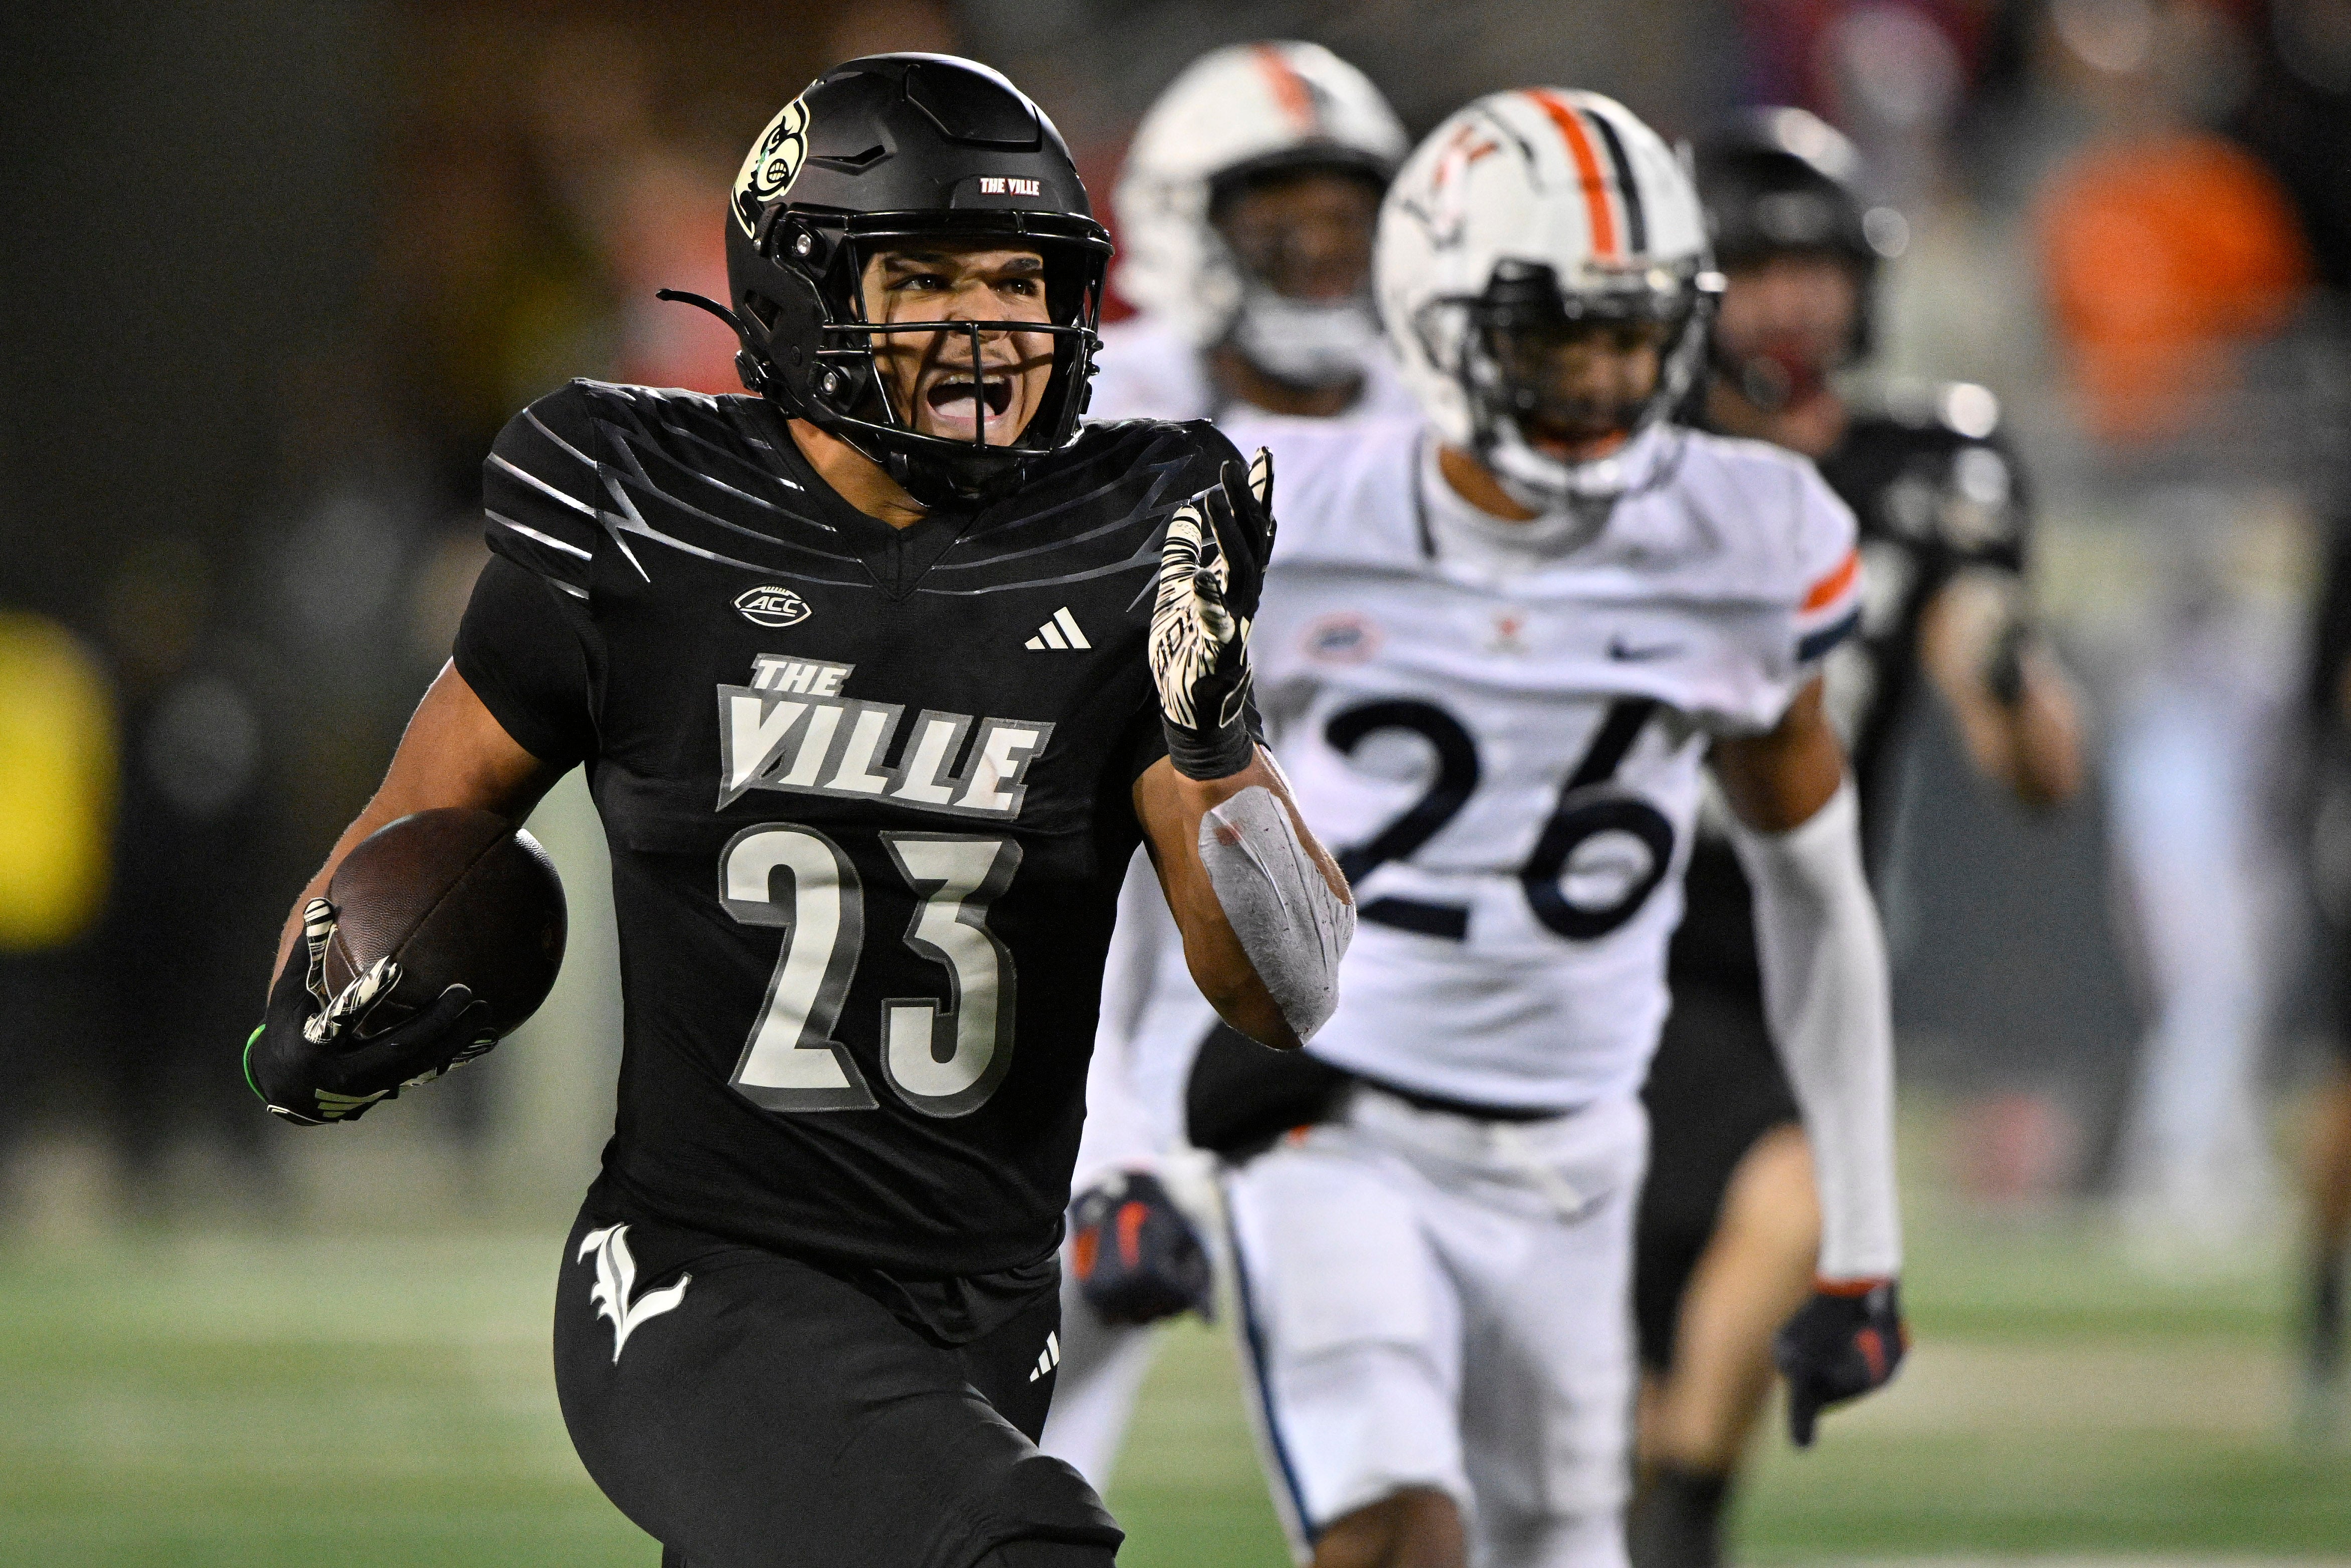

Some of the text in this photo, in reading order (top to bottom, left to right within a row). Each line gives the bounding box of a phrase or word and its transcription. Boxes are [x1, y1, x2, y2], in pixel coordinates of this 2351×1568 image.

[980, 178, 1039, 197] THE VILLE
[745, 596, 802, 613] ACC
[752, 657, 850, 696] THE
[722, 691, 1049, 815] VILLE
[1326, 696, 1675, 943] 26
[719, 823, 1022, 1117] 23
